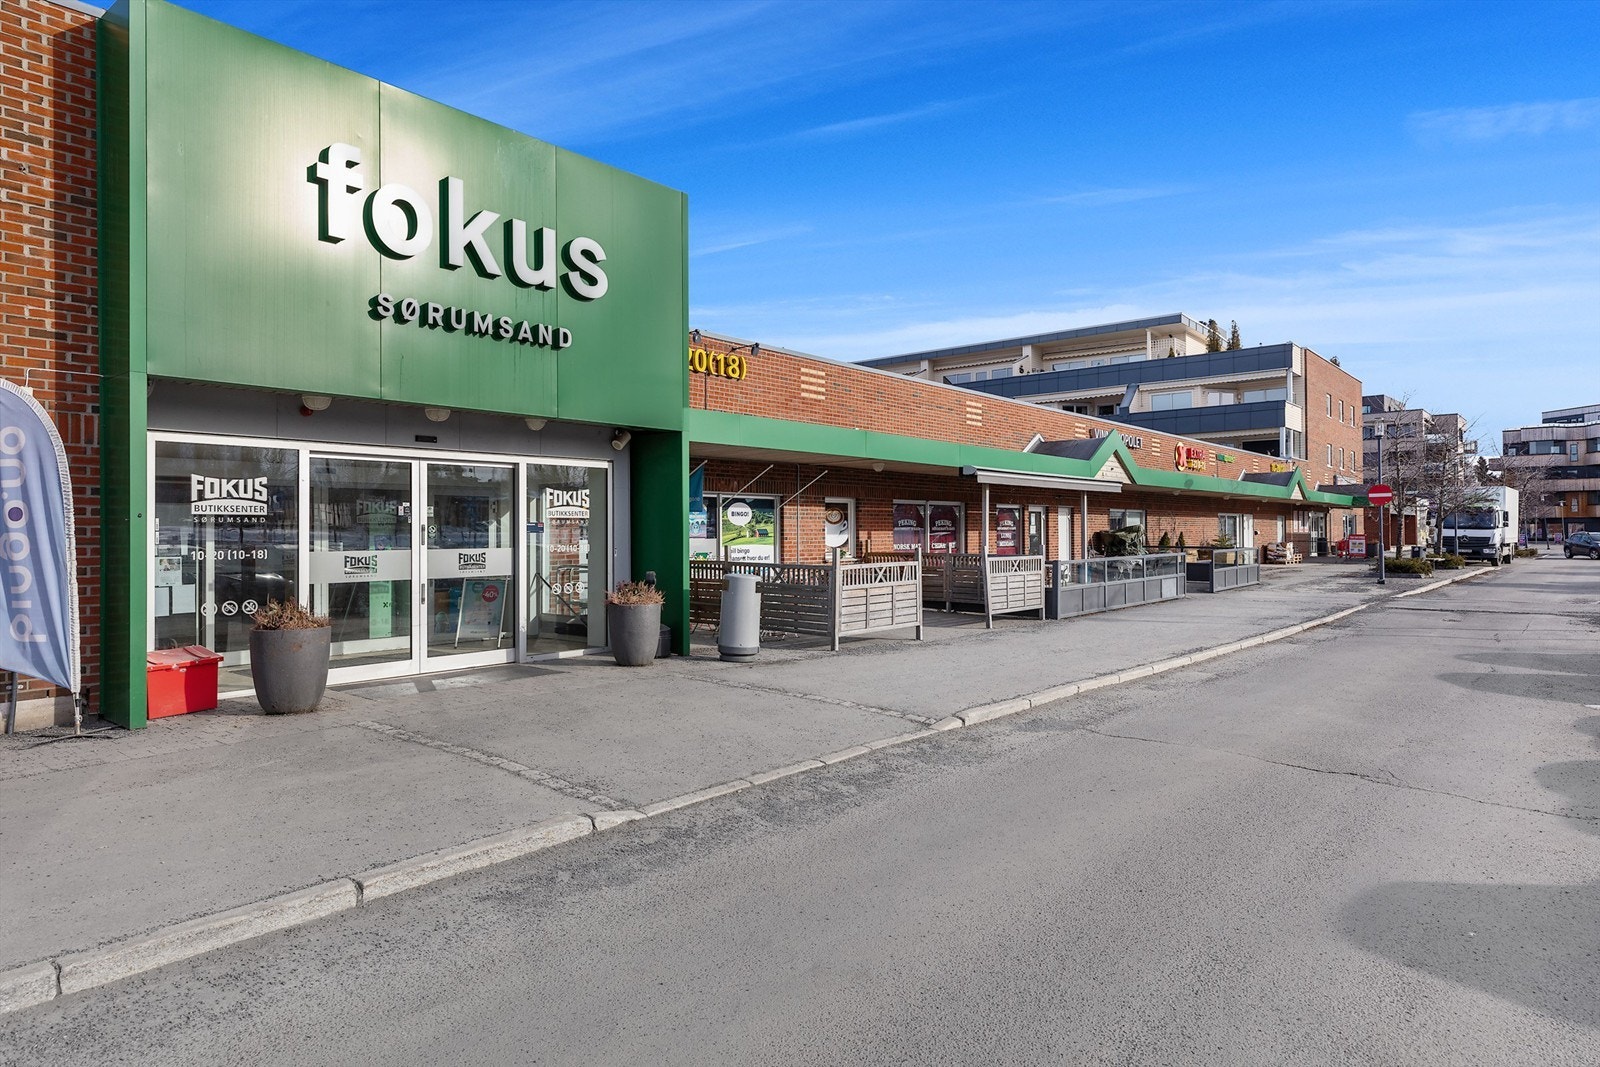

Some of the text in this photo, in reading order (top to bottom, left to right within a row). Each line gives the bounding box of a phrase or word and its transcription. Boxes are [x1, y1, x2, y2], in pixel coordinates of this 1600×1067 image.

[306, 142, 609, 302] fokus
[368, 292, 573, 350] SØRUMSAND
[191, 473, 268, 502] FOKUS
[546, 487, 590, 508] FOKUS
[194, 504, 265, 513] BUTIKKSENTER
[356, 500, 397, 517] FOKUS
[898, 519, 917, 527] PEKING
[190, 549, 268, 561] 1020 (10-18)
[458, 552, 487, 565] FOKUS
[737, 547, 750, 555] bingo
[344, 554, 378, 569] FOKUS
